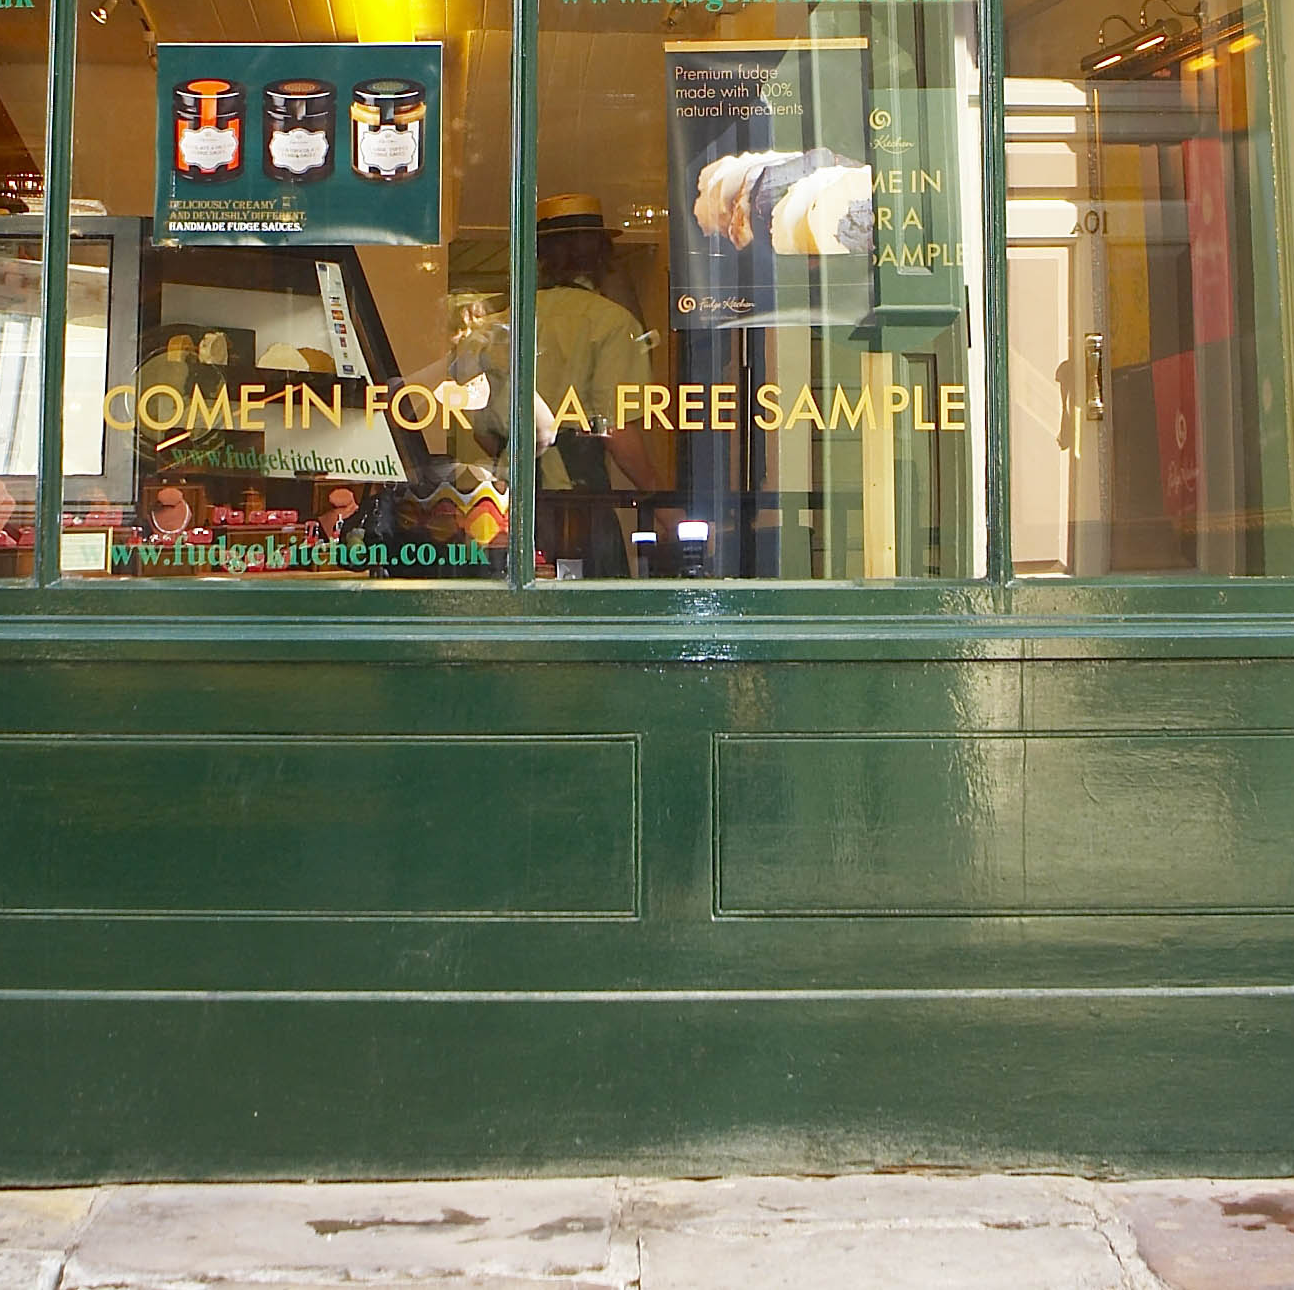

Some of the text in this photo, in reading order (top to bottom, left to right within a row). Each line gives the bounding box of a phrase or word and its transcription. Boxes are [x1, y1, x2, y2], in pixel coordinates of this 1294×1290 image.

[675, 63, 779, 83] Premium fudge
[675, 81, 794, 99] made with 100%
[676, 101, 804, 120] natural ingredients
[873, 133, 915, 154] Kitchen
[872, 169, 941, 193] ME IN
[169, 199, 277, 210] DELICIOUSLY CREAMY
[169, 211, 191, 220] AND
[192, 210, 249, 221] DEVILISHLY
[902, 206, 924, 230] A
[168, 221, 226, 232] HANDMADE
[227, 221, 260, 232] FUDGE
[103, 382, 967, 432] COME IN FOR A FREE SAMPLE
